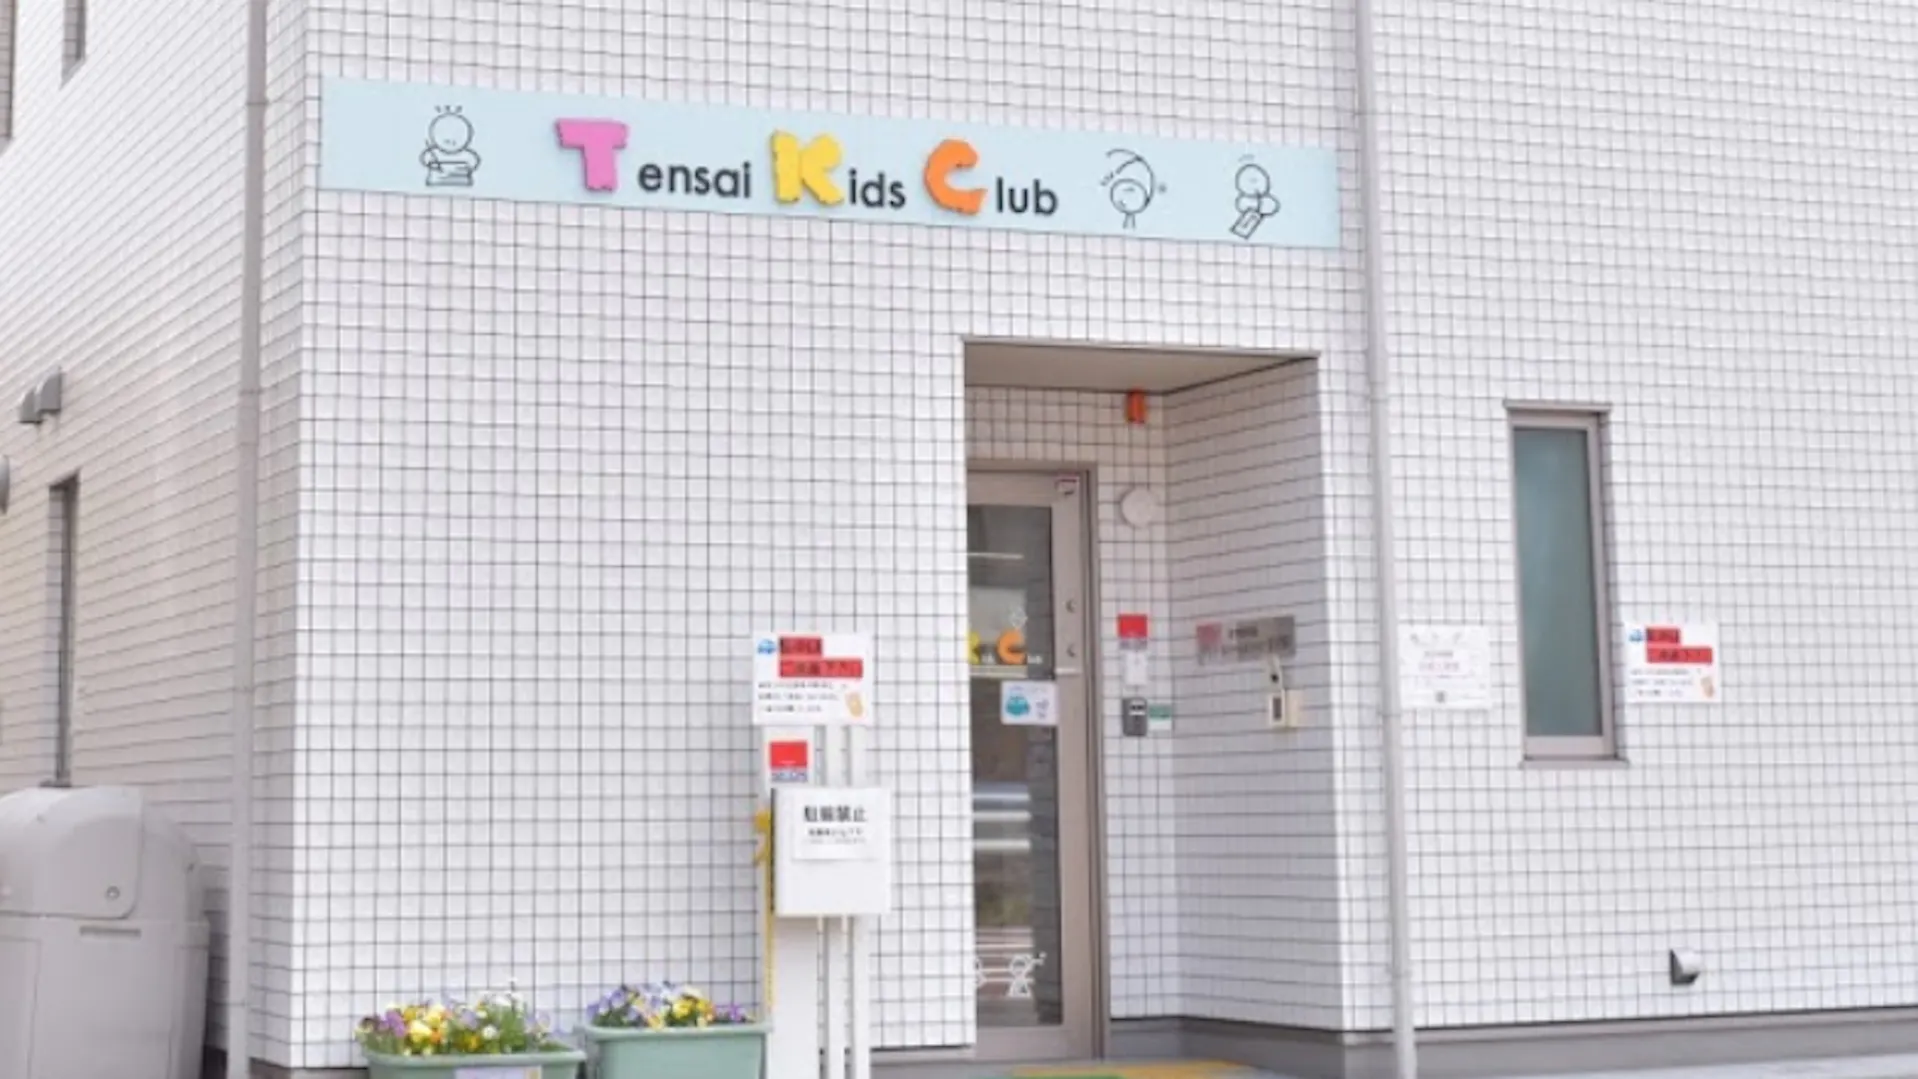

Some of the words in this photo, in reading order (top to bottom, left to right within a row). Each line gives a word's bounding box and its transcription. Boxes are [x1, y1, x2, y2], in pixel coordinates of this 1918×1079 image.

[555, 118, 752, 199] Tensai
[770, 129, 907, 211] Kids
[923, 137, 1060, 216] Club
